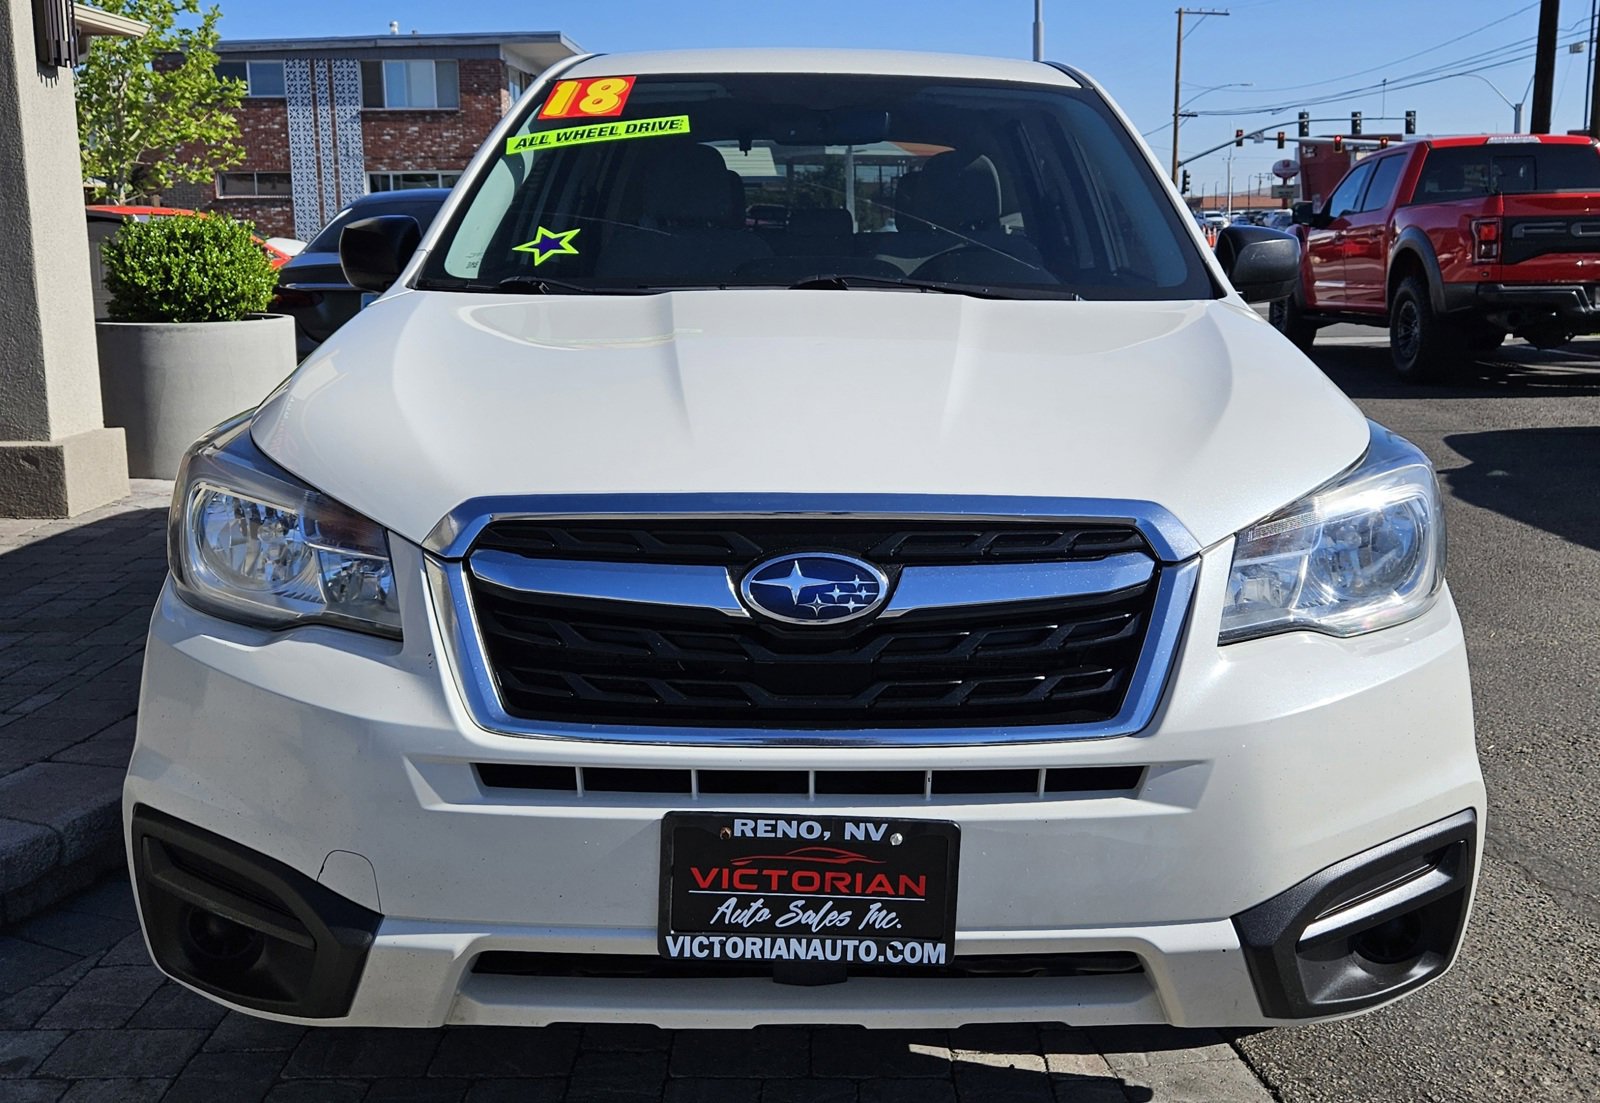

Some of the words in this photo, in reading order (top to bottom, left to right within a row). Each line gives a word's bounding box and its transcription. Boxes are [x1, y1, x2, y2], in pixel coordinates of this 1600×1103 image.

[543, 78, 629, 117] 18
[514, 137, 548, 149] ALL
[556, 125, 618, 142] WHEEL
[624, 119, 681, 134] DRIVE
[733, 819, 831, 841] RENO,
[844, 822, 888, 841] NV
[690, 867, 927, 897] VICTORIAN
[710, 897, 771, 926] Auto
[775, 900, 852, 933] Sales
[858, 902, 903, 931] Inc.
[666, 936, 946, 964] VICTORIANAUTO.COM
